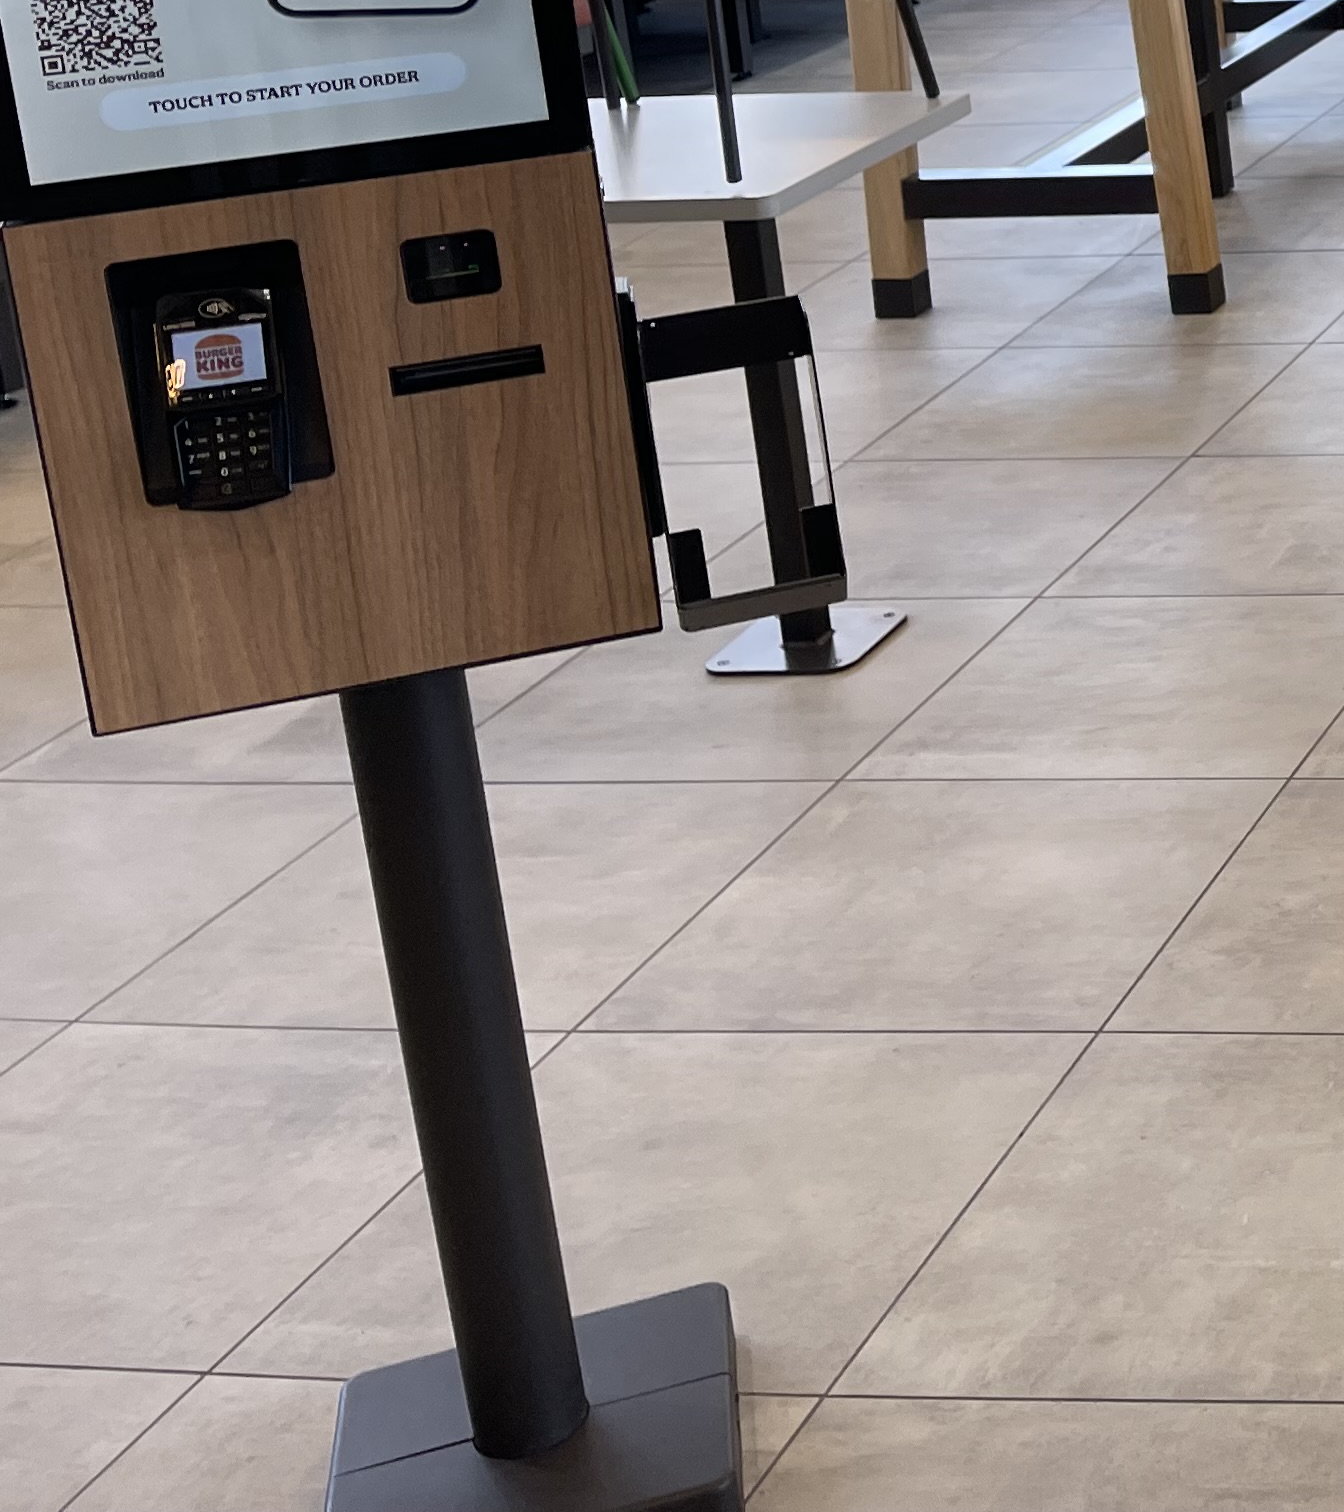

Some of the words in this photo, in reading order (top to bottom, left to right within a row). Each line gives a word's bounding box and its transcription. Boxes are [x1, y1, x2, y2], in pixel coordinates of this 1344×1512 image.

[46, 78, 79, 92] Scan
[81, 76, 97, 88] to
[98, 67, 166, 86] download
[148, 94, 214, 115] TOUCH
[216, 90, 243, 107] TO
[245, 83, 304, 103] START
[304, 77, 357, 96] YOUR
[358, 69, 420, 90] ORDER
[195, 345, 243, 359] BURGER
[196, 355, 244, 374] KING
